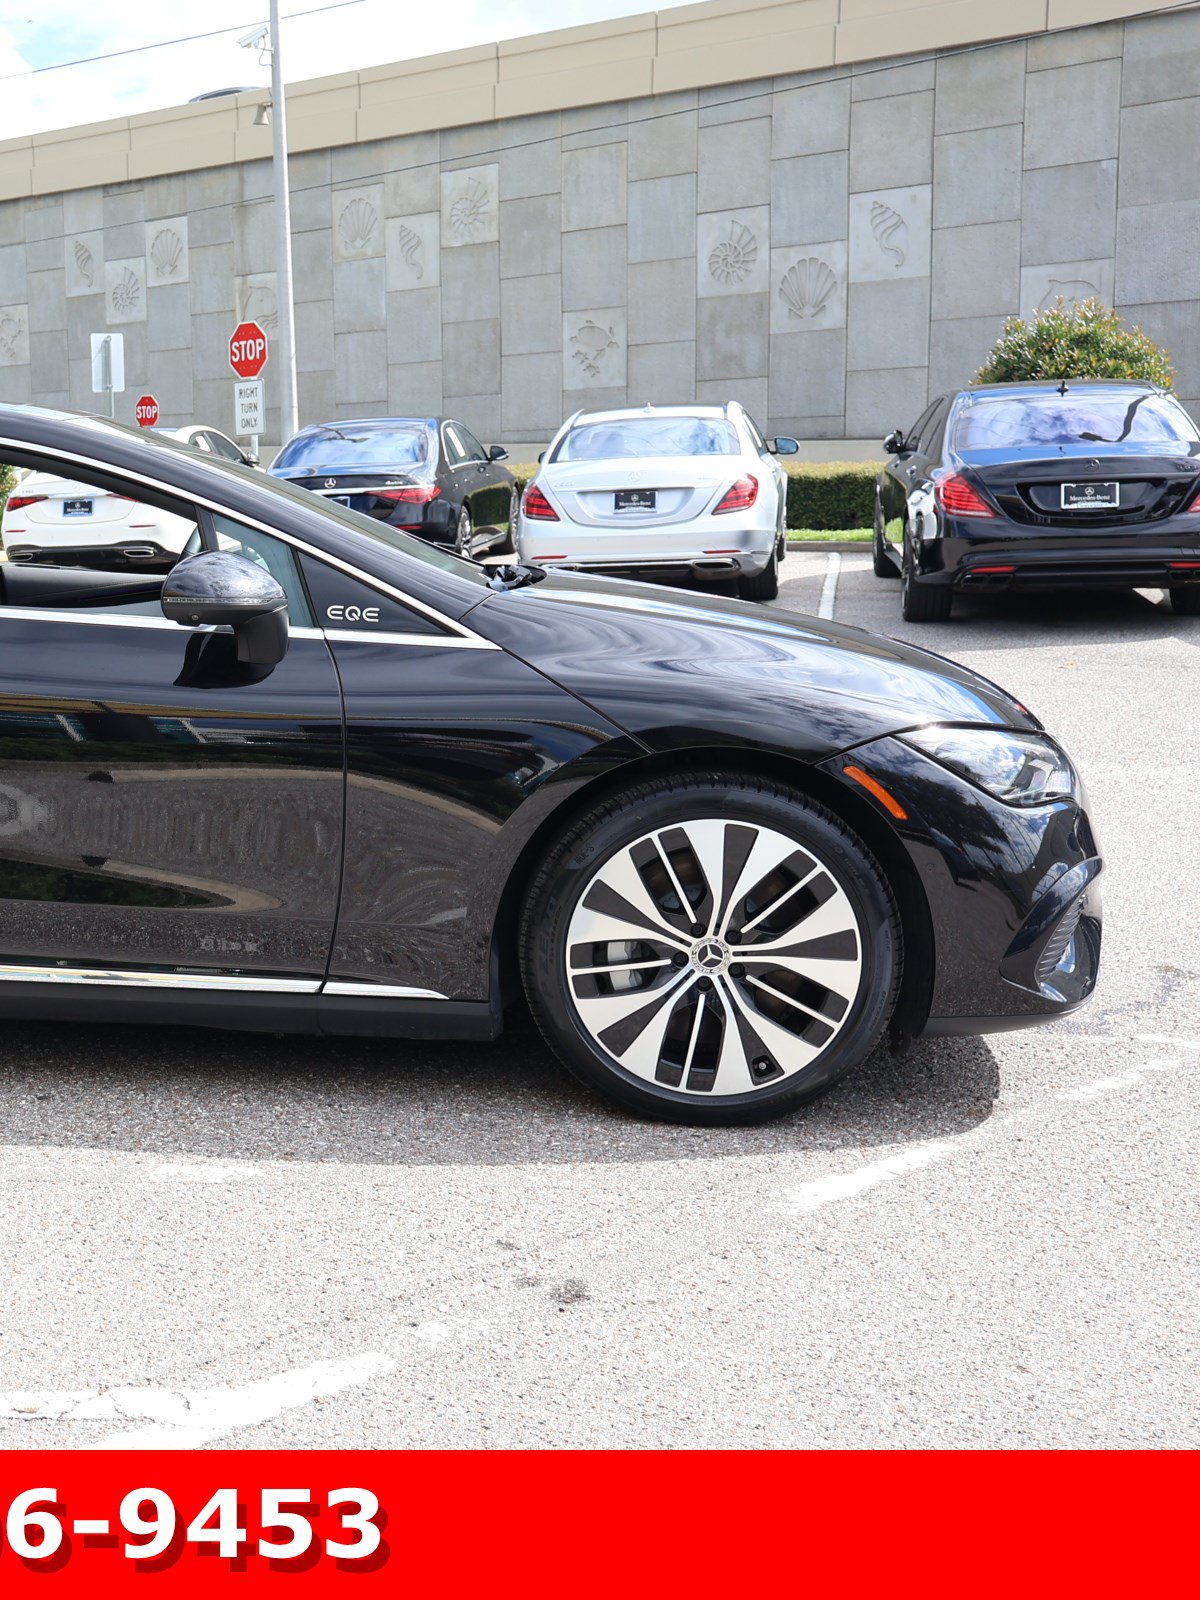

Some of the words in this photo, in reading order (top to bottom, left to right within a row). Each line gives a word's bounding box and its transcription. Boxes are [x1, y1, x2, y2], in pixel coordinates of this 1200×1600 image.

[231, 338, 265, 362] STOP
[238, 387, 258, 399] RIGHT
[136, 405, 158, 419] STOP
[240, 403, 258, 414] TURN
[240, 418, 258, 429] ONLY
[326, 604, 380, 623] EQE
